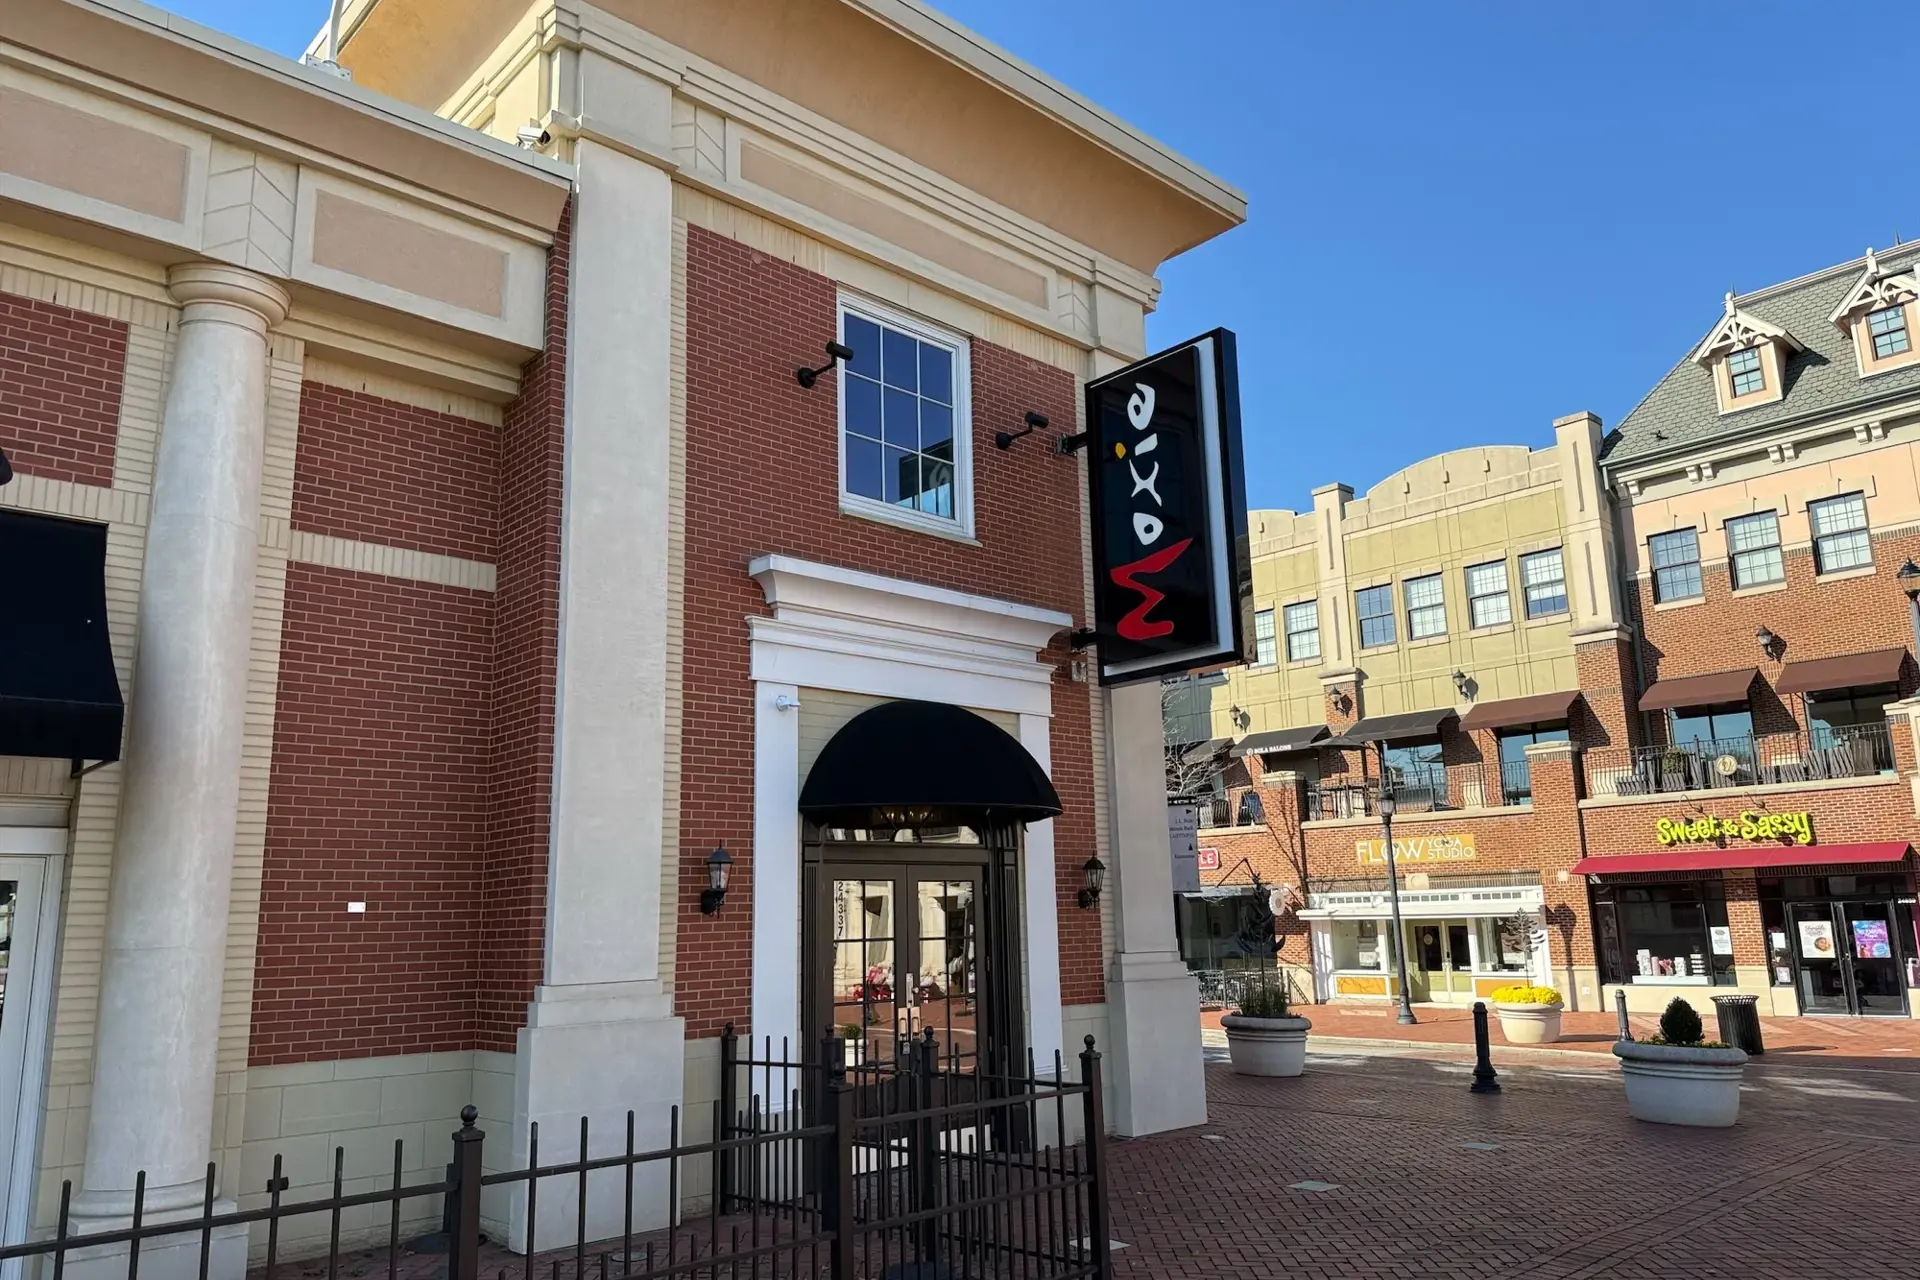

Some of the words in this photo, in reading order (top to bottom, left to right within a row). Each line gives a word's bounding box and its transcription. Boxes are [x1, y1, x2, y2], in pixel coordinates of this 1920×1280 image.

[1110, 382, 1193, 640] Moxie
[1657, 815, 1719, 844] Sweet
[1722, 818, 1739, 836] &
[1740, 810, 1811, 844] Sassy
[1356, 839, 1424, 862] FLOW
[1427, 837, 1462, 848] YOGA
[1427, 846, 1474, 859] STUDIO
